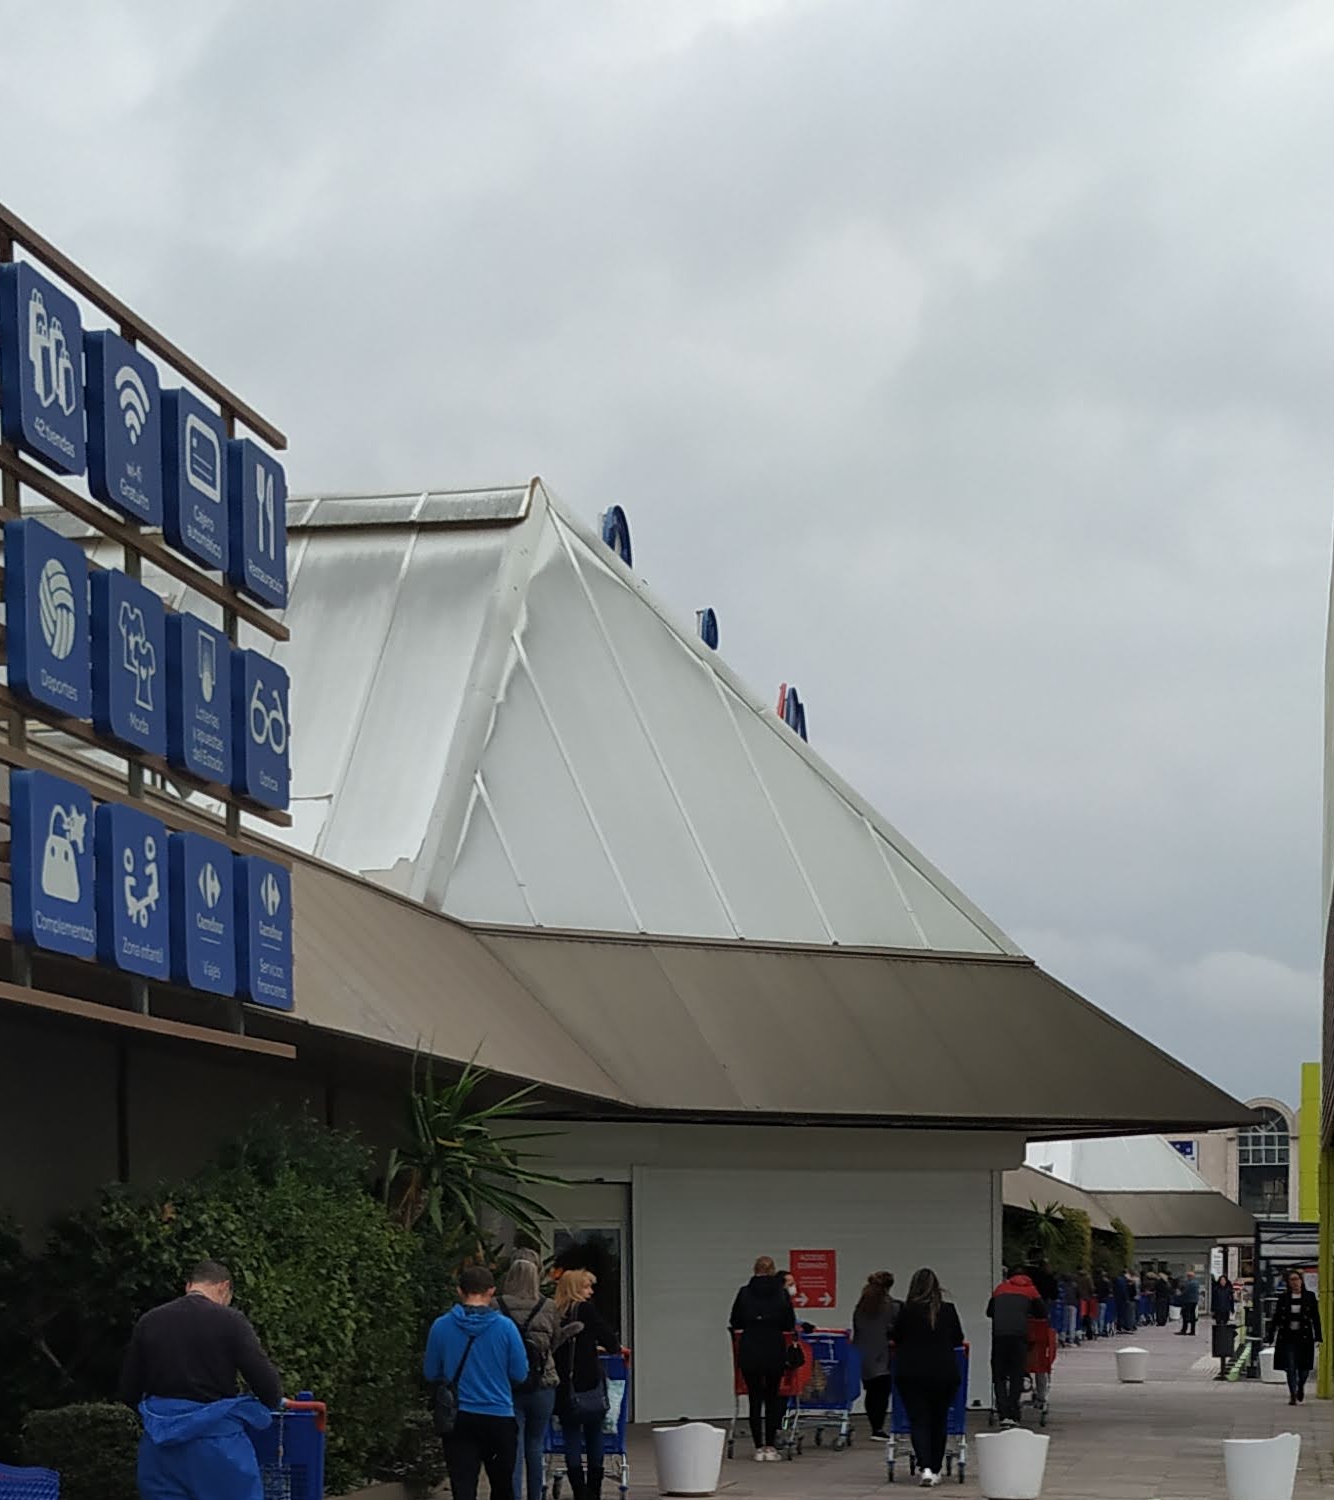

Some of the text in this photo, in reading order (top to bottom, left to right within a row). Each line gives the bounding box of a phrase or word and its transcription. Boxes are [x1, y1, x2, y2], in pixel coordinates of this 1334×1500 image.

[40, 667, 79, 702] Deportes
[35, 909, 95, 943] Complementos
[122, 936, 140, 957] Zona
